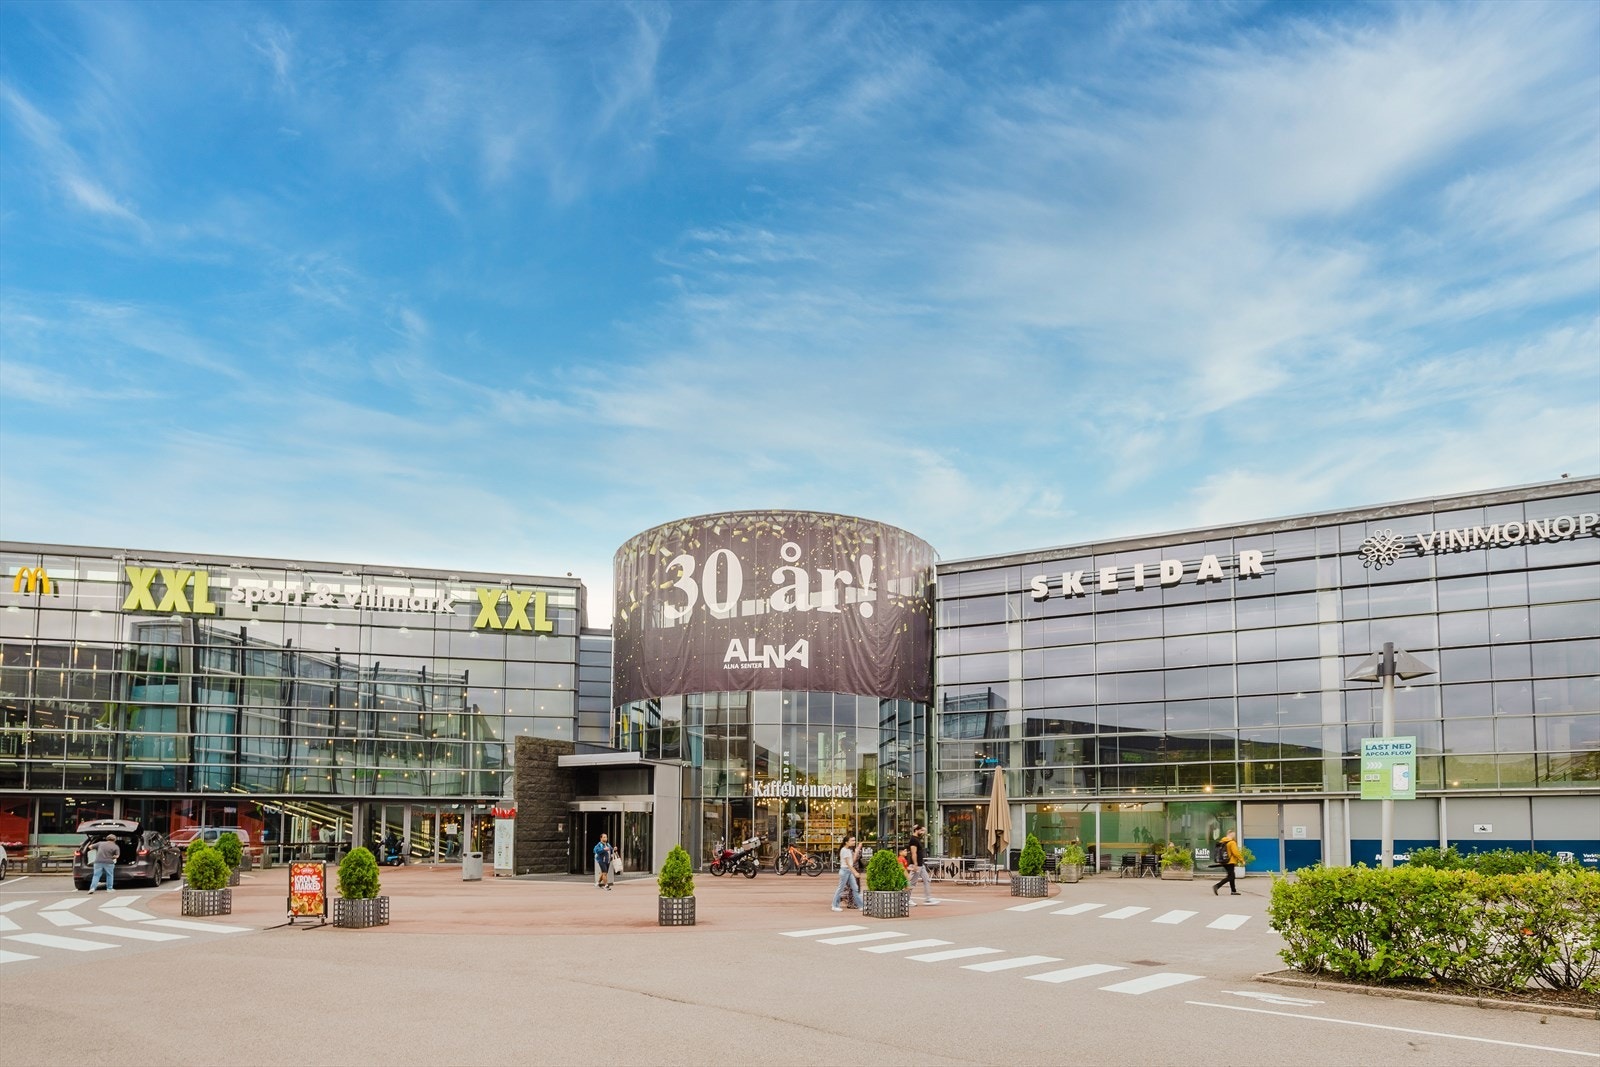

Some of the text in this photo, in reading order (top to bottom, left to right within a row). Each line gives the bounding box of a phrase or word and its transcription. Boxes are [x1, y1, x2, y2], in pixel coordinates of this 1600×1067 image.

[1416, 512, 1599, 551] VINMONOP
[664, 541, 874, 619] 30 år!
[1031, 549, 1265, 598] SKEIDAR
[122, 566, 553, 632] XXL sport & villmark XXL
[723, 638, 809, 669] ALNA
[754, 780, 853, 798] Kaffebrenneriet
[294, 882, 320, 891] MARKED
